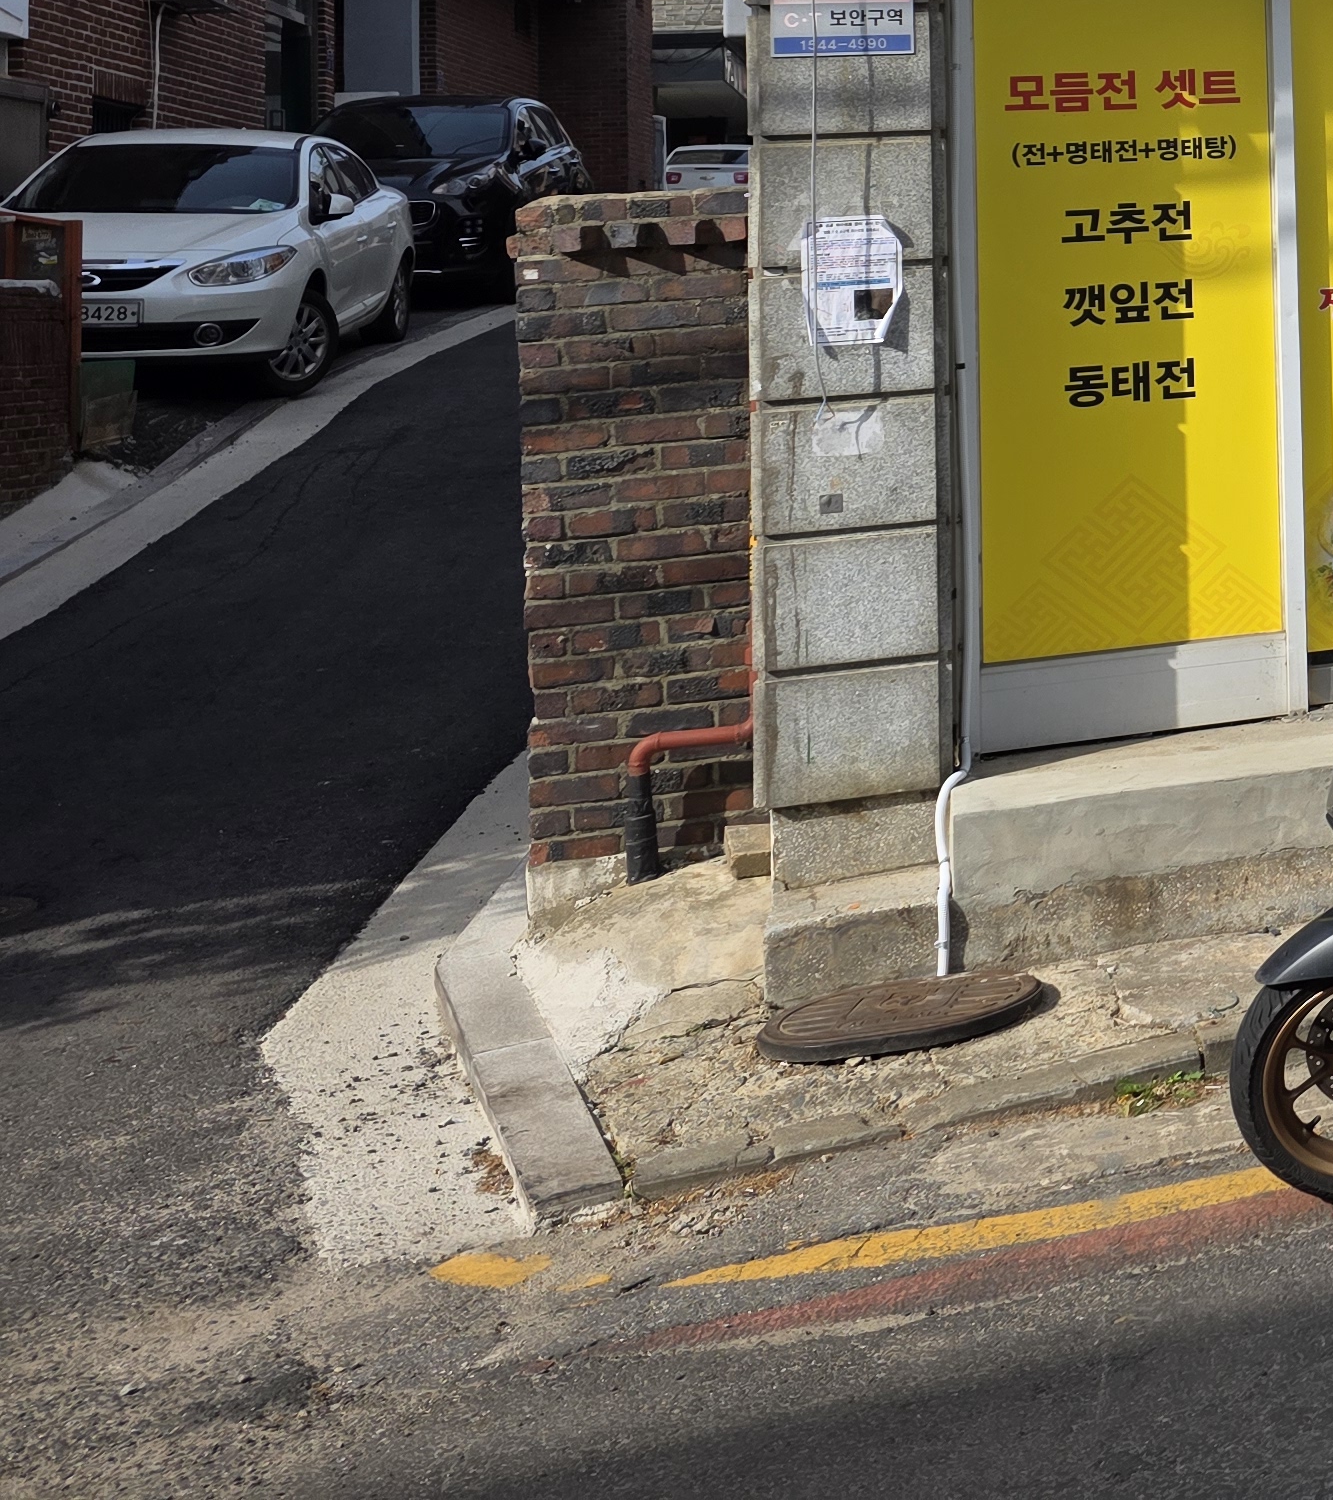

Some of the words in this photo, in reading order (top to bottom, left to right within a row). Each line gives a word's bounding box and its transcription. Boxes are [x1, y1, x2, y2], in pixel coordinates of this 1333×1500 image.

[830, 9, 903, 26] 보안구역
[800, 38, 887, 51] 1544-4990
[1004, 70, 1138, 113] 모듬전
[1154, 68, 1241, 109] 셋트
[1011, 135, 1237, 168] (전+명태전+명태탕)
[1061, 201, 1193, 244] 고추전
[1063, 279, 1194, 326] 깻잎전
[1064, 358, 1196, 408] 동태전
